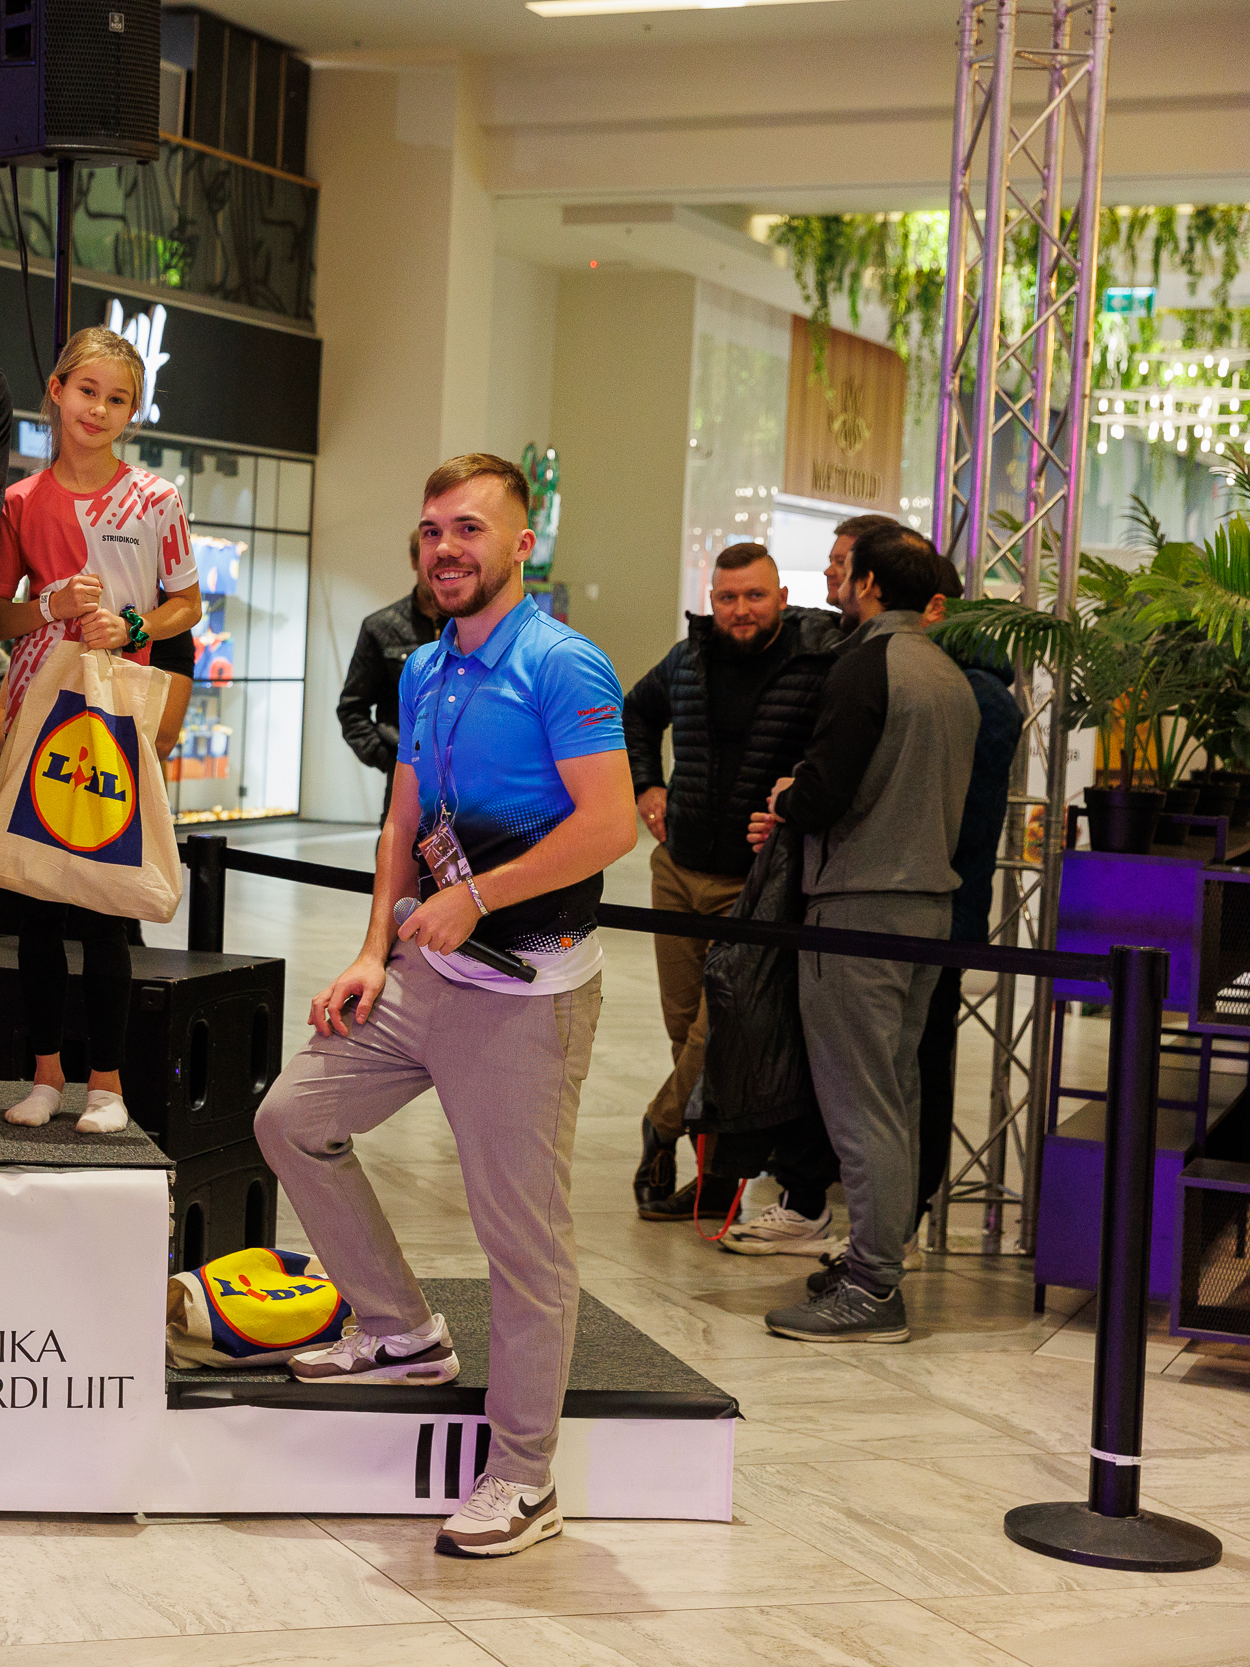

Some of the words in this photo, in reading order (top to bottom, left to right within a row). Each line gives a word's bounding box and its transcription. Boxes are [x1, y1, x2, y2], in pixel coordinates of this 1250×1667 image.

[102, 534, 140, 545] STRIIDIKOOL
[213, 1274, 326, 1302] LIDL
[66, 1376, 135, 1409] LIIT
